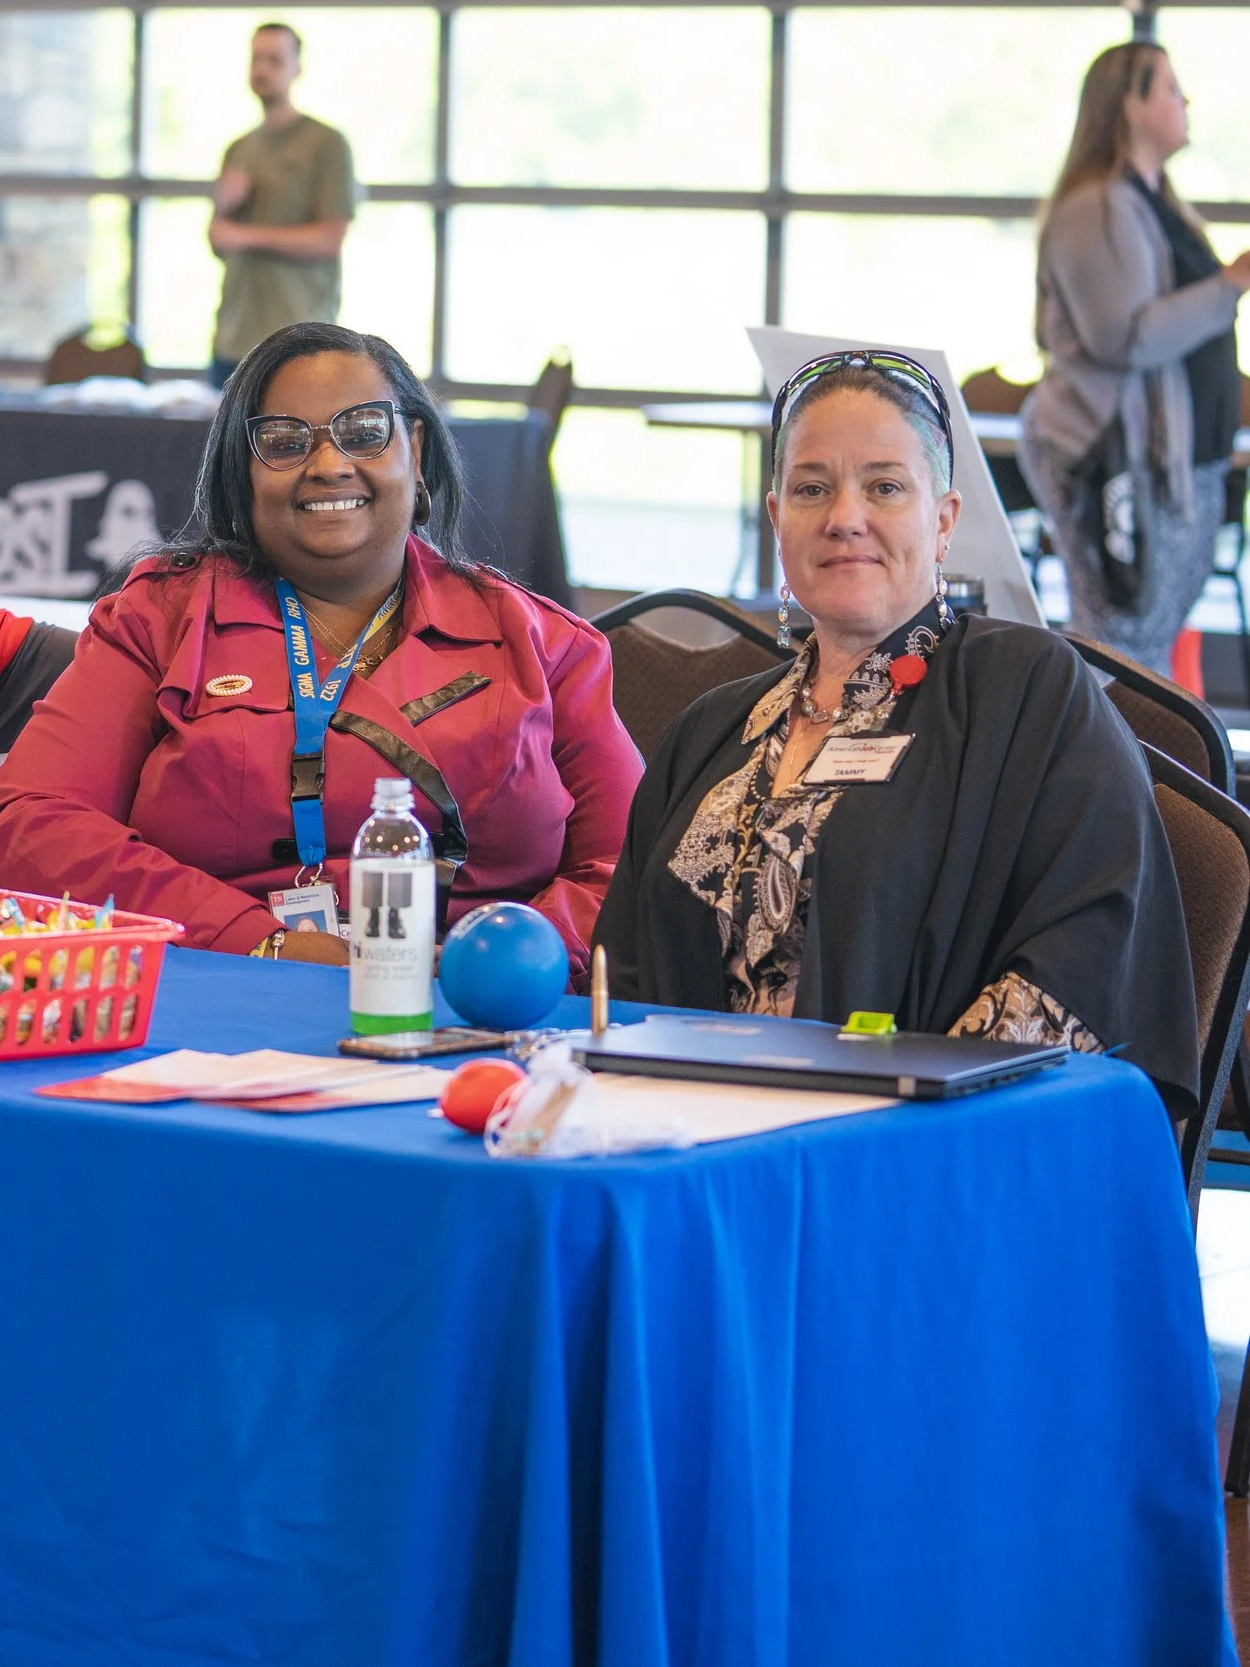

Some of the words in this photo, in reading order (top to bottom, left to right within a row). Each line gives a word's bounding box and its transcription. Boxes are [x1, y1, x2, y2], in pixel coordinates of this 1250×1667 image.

[285, 597, 301, 619] RHO
[291, 625, 309, 665] GAMMA
[297, 673, 315, 698] SIGMA
[320, 679, 342, 701] 1922
